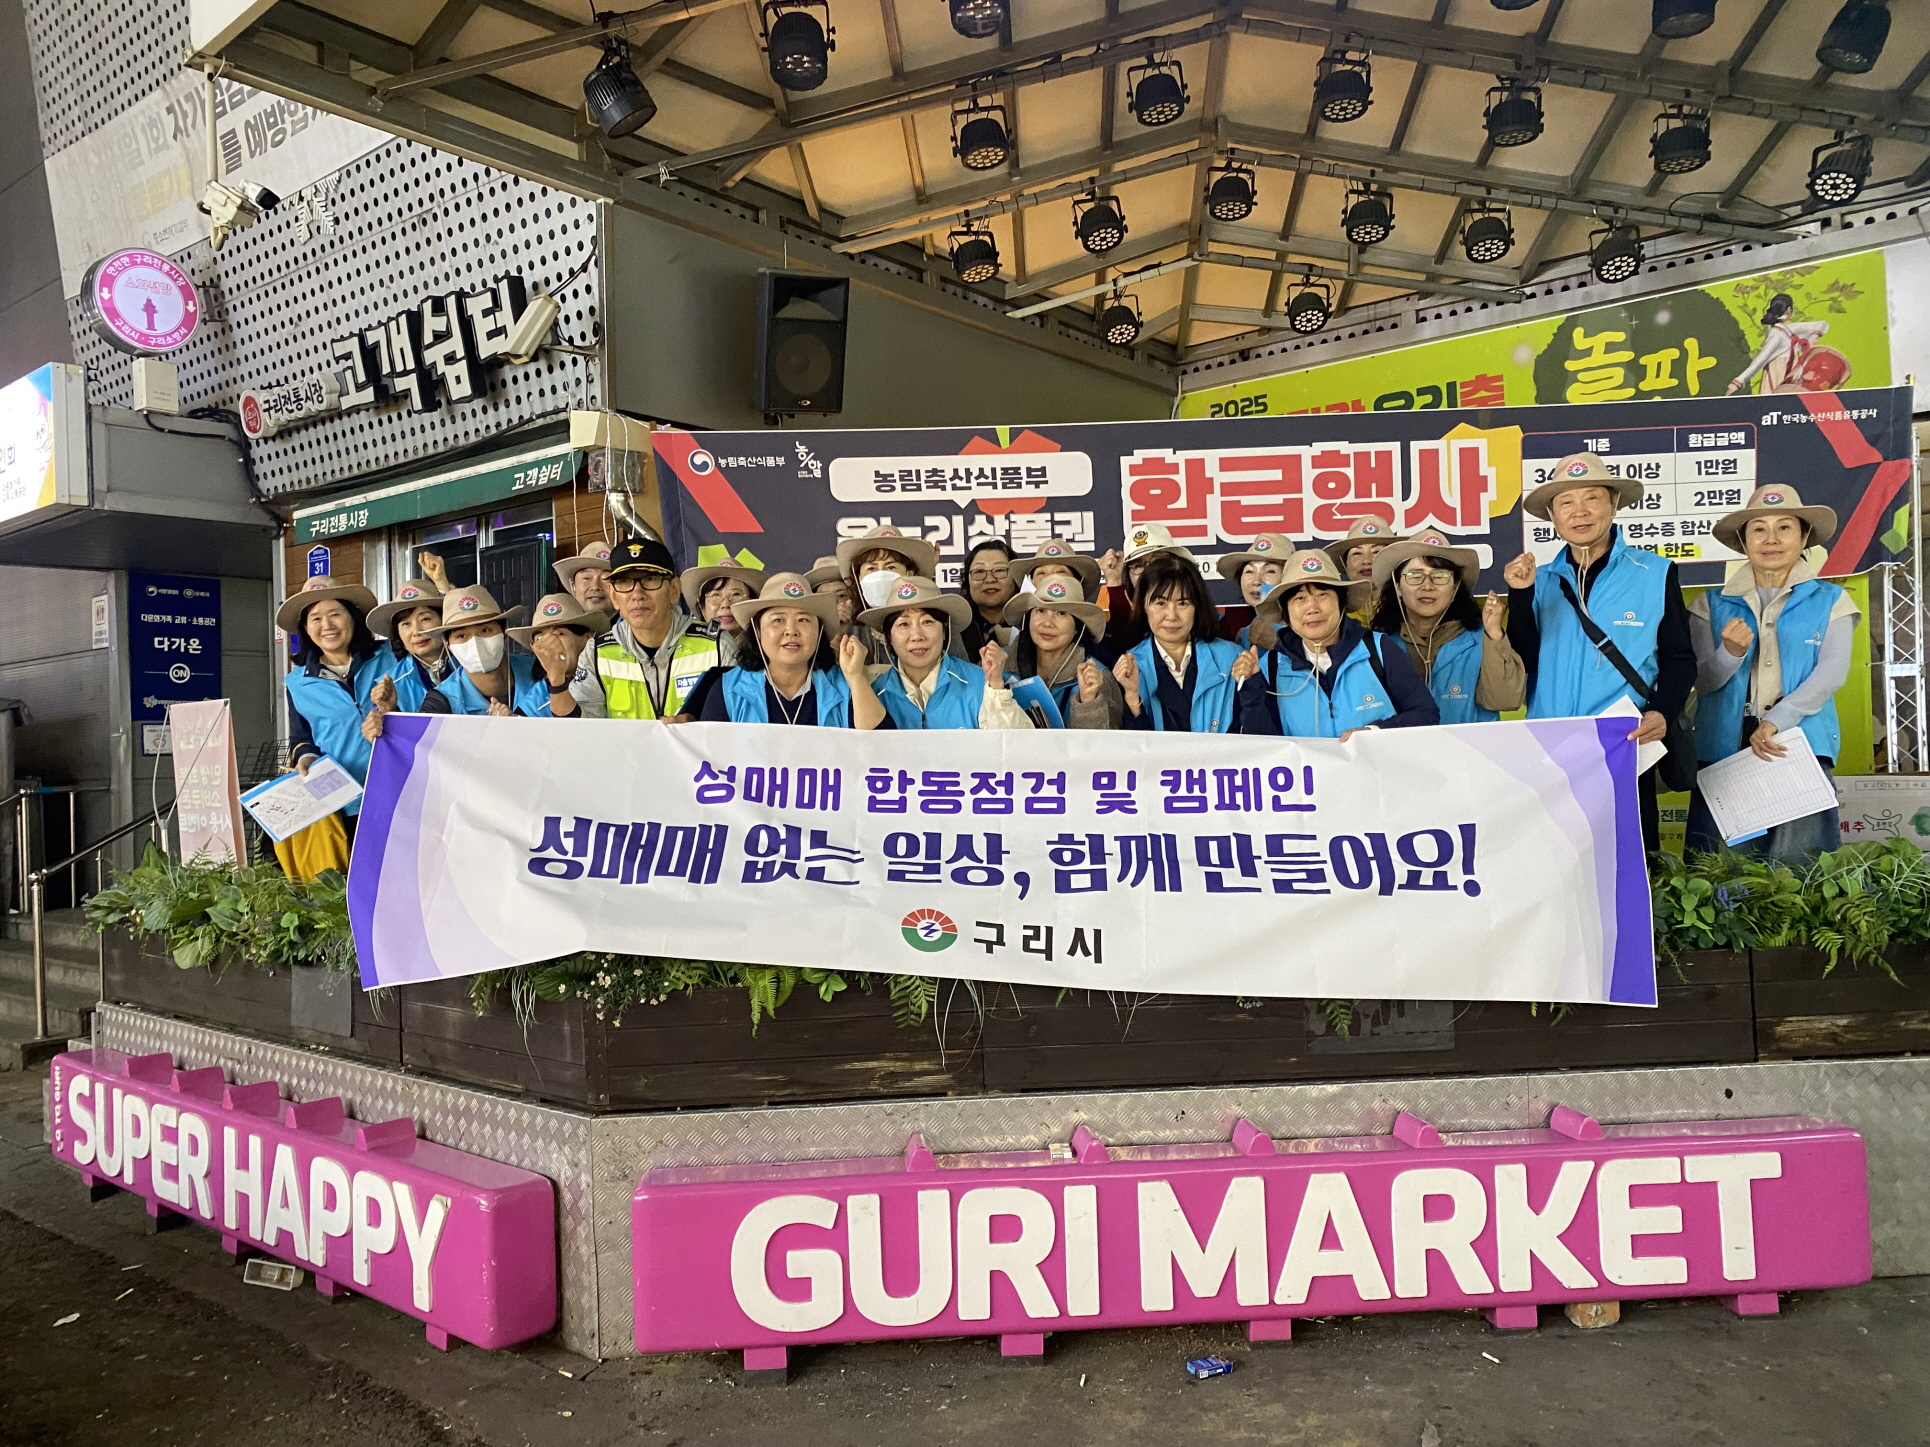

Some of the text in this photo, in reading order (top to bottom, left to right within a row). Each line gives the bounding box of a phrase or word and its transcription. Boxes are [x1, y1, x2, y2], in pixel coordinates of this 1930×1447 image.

[106, 254, 186, 288] 안전한 구리전통시장
[113, 318, 188, 346] 구리시 구리소방서
[331, 275, 527, 413] 고객쉼터
[262, 378, 325, 421] 구리전통시장
[1209, 394, 1269, 418] 2025
[1761, 408, 1878, 426] aT 한국농수산식품유통공사
[1583, 431, 1746, 452] 기준 환급금액
[511, 460, 564, 491] 고객쉼터
[717, 456, 786, 468] 농림축산식품부
[1626, 462, 1662, 479] 이상
[1695, 458, 1738, 476] 1만원
[872, 463, 1050, 494] 농림축산식품부
[1124, 441, 1493, 541] 환급행사
[1693, 488, 1742, 508] 2만원
[309, 508, 370, 538] 구리전통시장
[1628, 522, 1676, 539] 영수증
[1680, 519, 1712, 536] 합산
[1663, 542, 1695, 559] 한도
[314, 561, 324, 575] 31
[153, 637, 203, 654] 다가온
[172, 669, 187, 678] ON
[693, 760, 1318, 815] 성매매 합동점검 및 캠페인
[526, 815, 1482, 900] 성매매 없는 일상, 함께 만들어요!
[973, 920, 1104, 965] 구리시
[68, 1073, 452, 1313] SUPER HAPPY
[730, 1151, 1783, 1333] GURI MARKET
